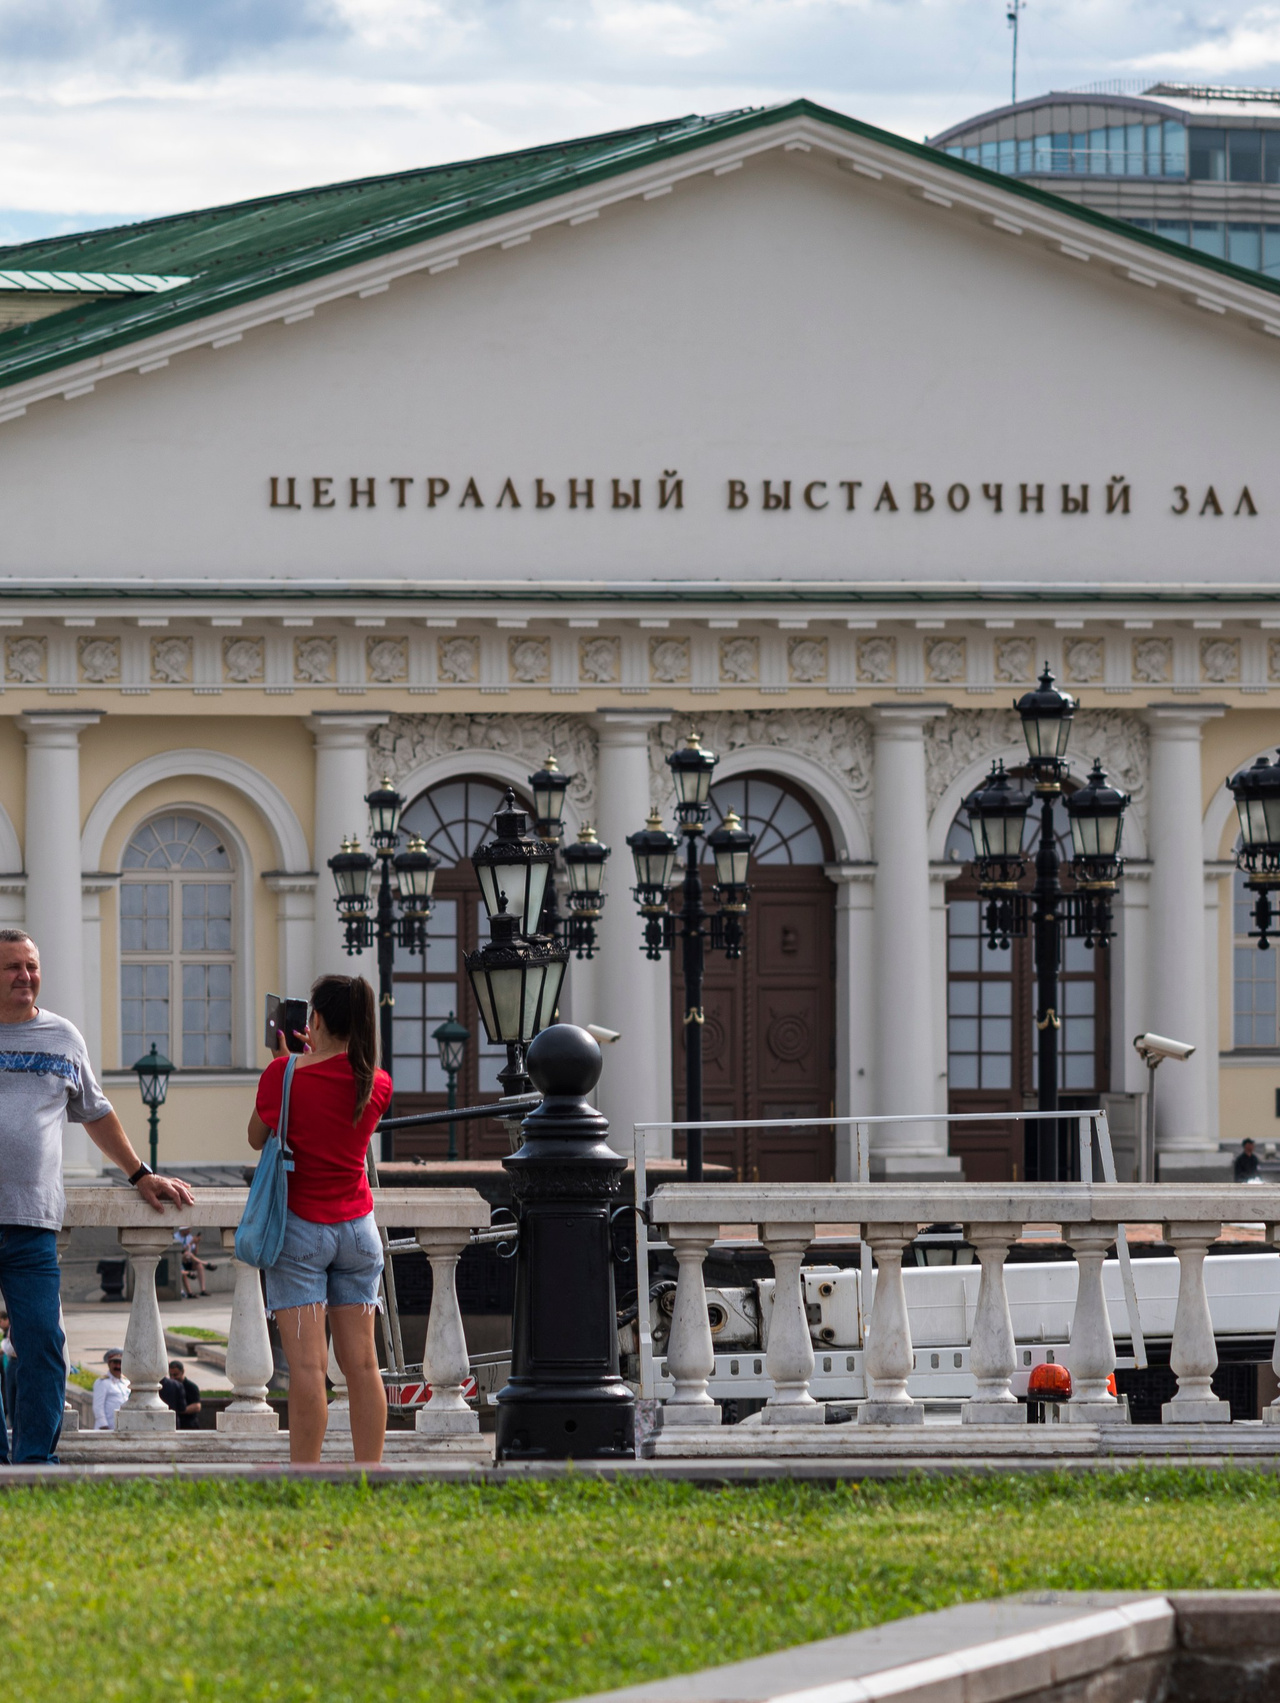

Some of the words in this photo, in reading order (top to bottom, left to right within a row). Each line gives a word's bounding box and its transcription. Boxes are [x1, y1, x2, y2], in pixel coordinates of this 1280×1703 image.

[269, 469, 684, 511] ЦЕНТРАЛЬНЫЙ
[726, 475, 1131, 516] ВЫСТАВОЧНЫЙ
[1170, 484, 1259, 518] ЗАЛ
